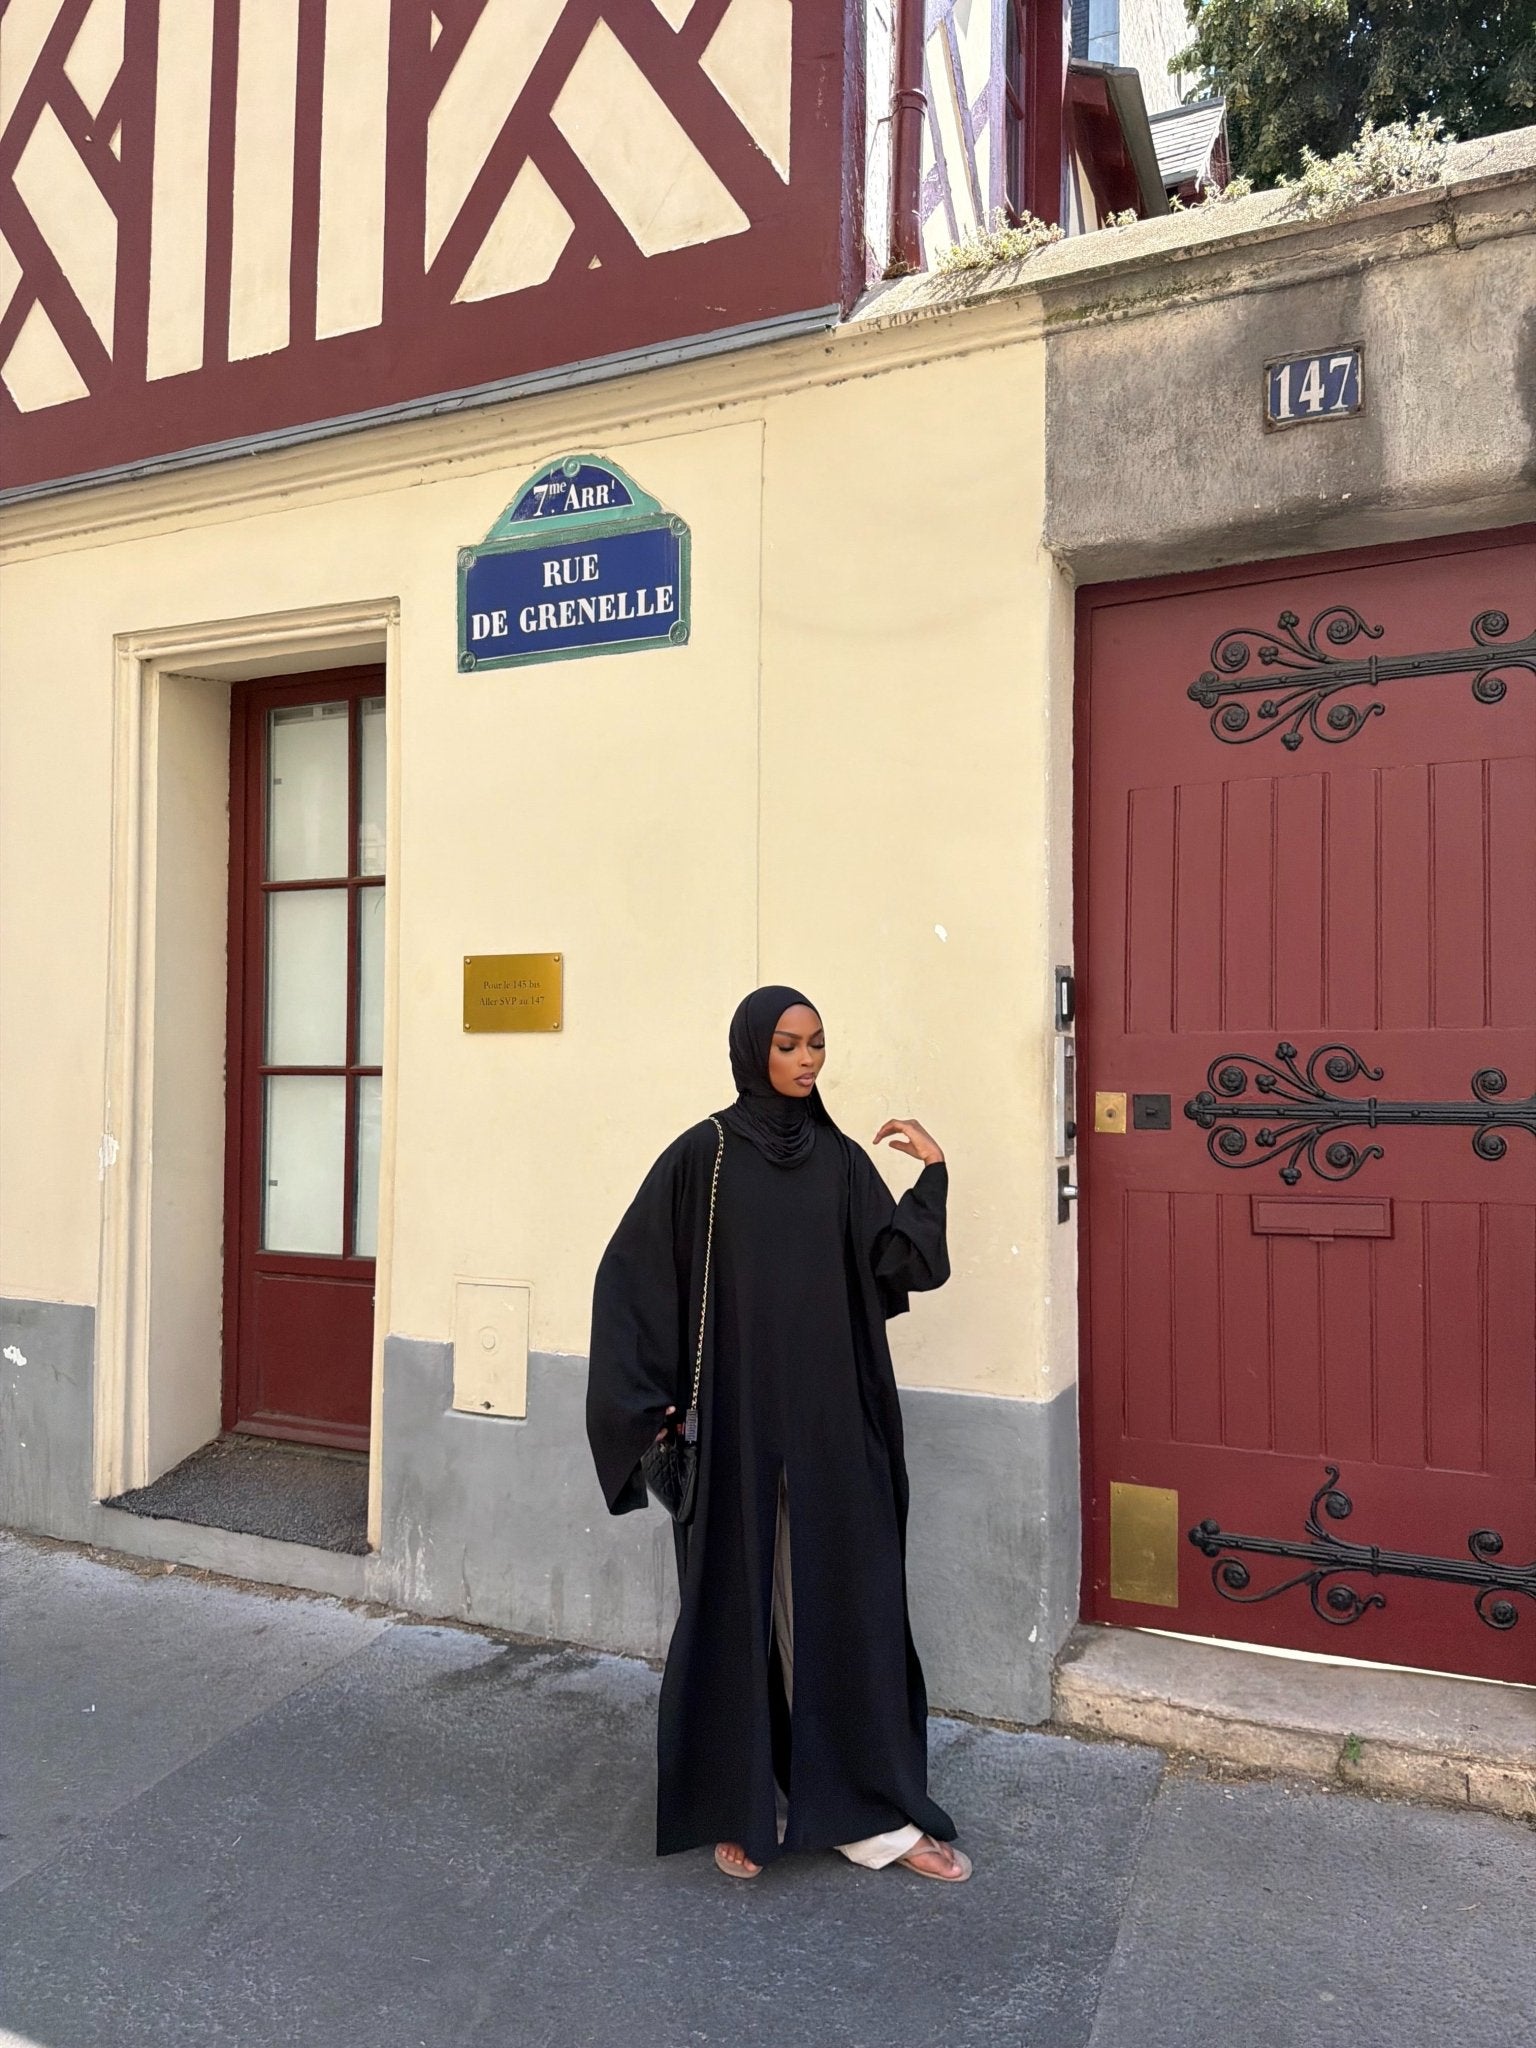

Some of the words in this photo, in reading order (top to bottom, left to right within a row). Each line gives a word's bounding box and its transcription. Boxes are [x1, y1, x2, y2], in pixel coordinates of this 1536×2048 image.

[1274, 356, 1352, 420] 147
[542, 554, 599, 588] RUE
[471, 610, 508, 641] DE
[519, 585, 674, 634] GRENELLE
[480, 997, 497, 1006] Aller
[499, 996, 517, 1005] SVP
[530, 996, 545, 1005] 147
[483, 980, 502, 989] Pour
[503, 980, 511, 989] le
[513, 980, 527, 989] 145
[529, 979, 541, 988] bis
